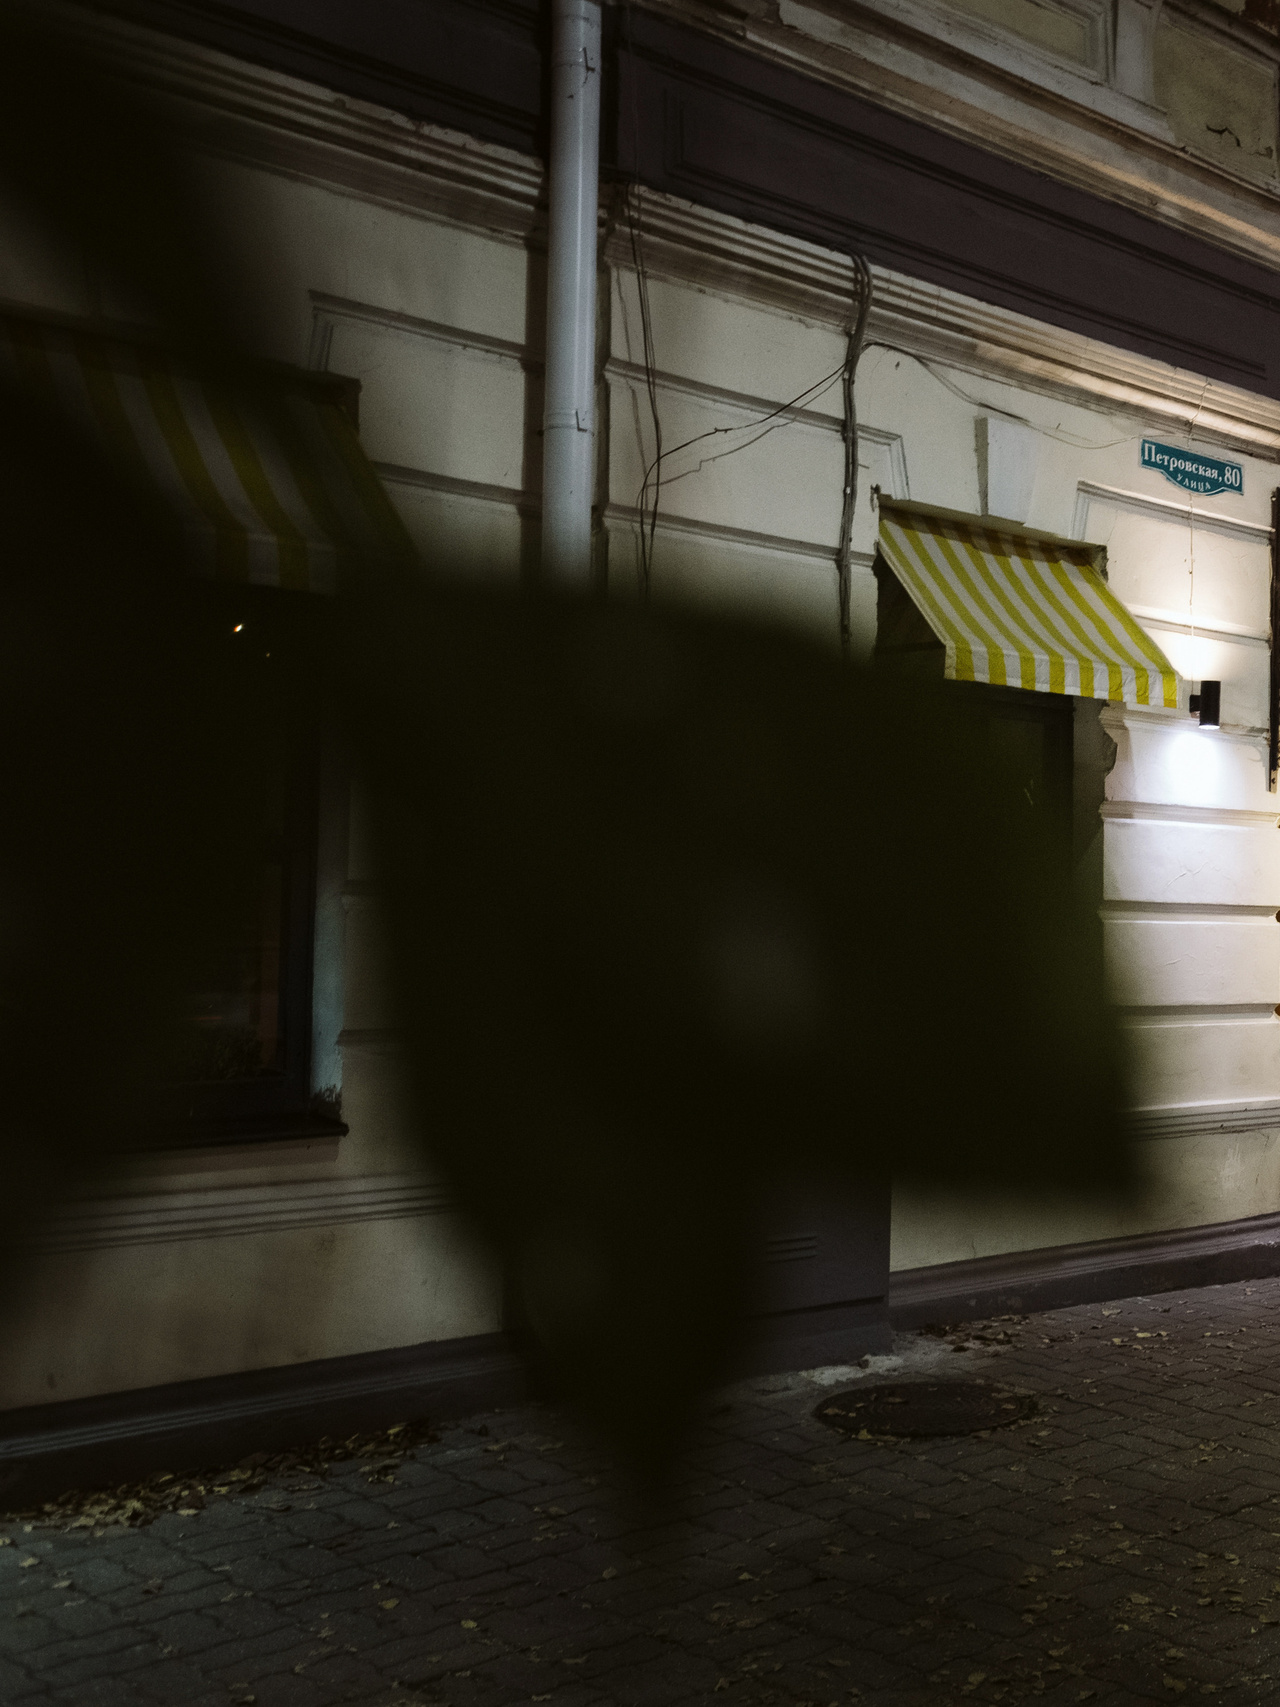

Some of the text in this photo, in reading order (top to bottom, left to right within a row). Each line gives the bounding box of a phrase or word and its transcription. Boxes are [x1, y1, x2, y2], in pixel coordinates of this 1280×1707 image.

[1143, 443, 1240, 487] Петровская, 80
[1176, 473, 1212, 492] УЛИЦА
